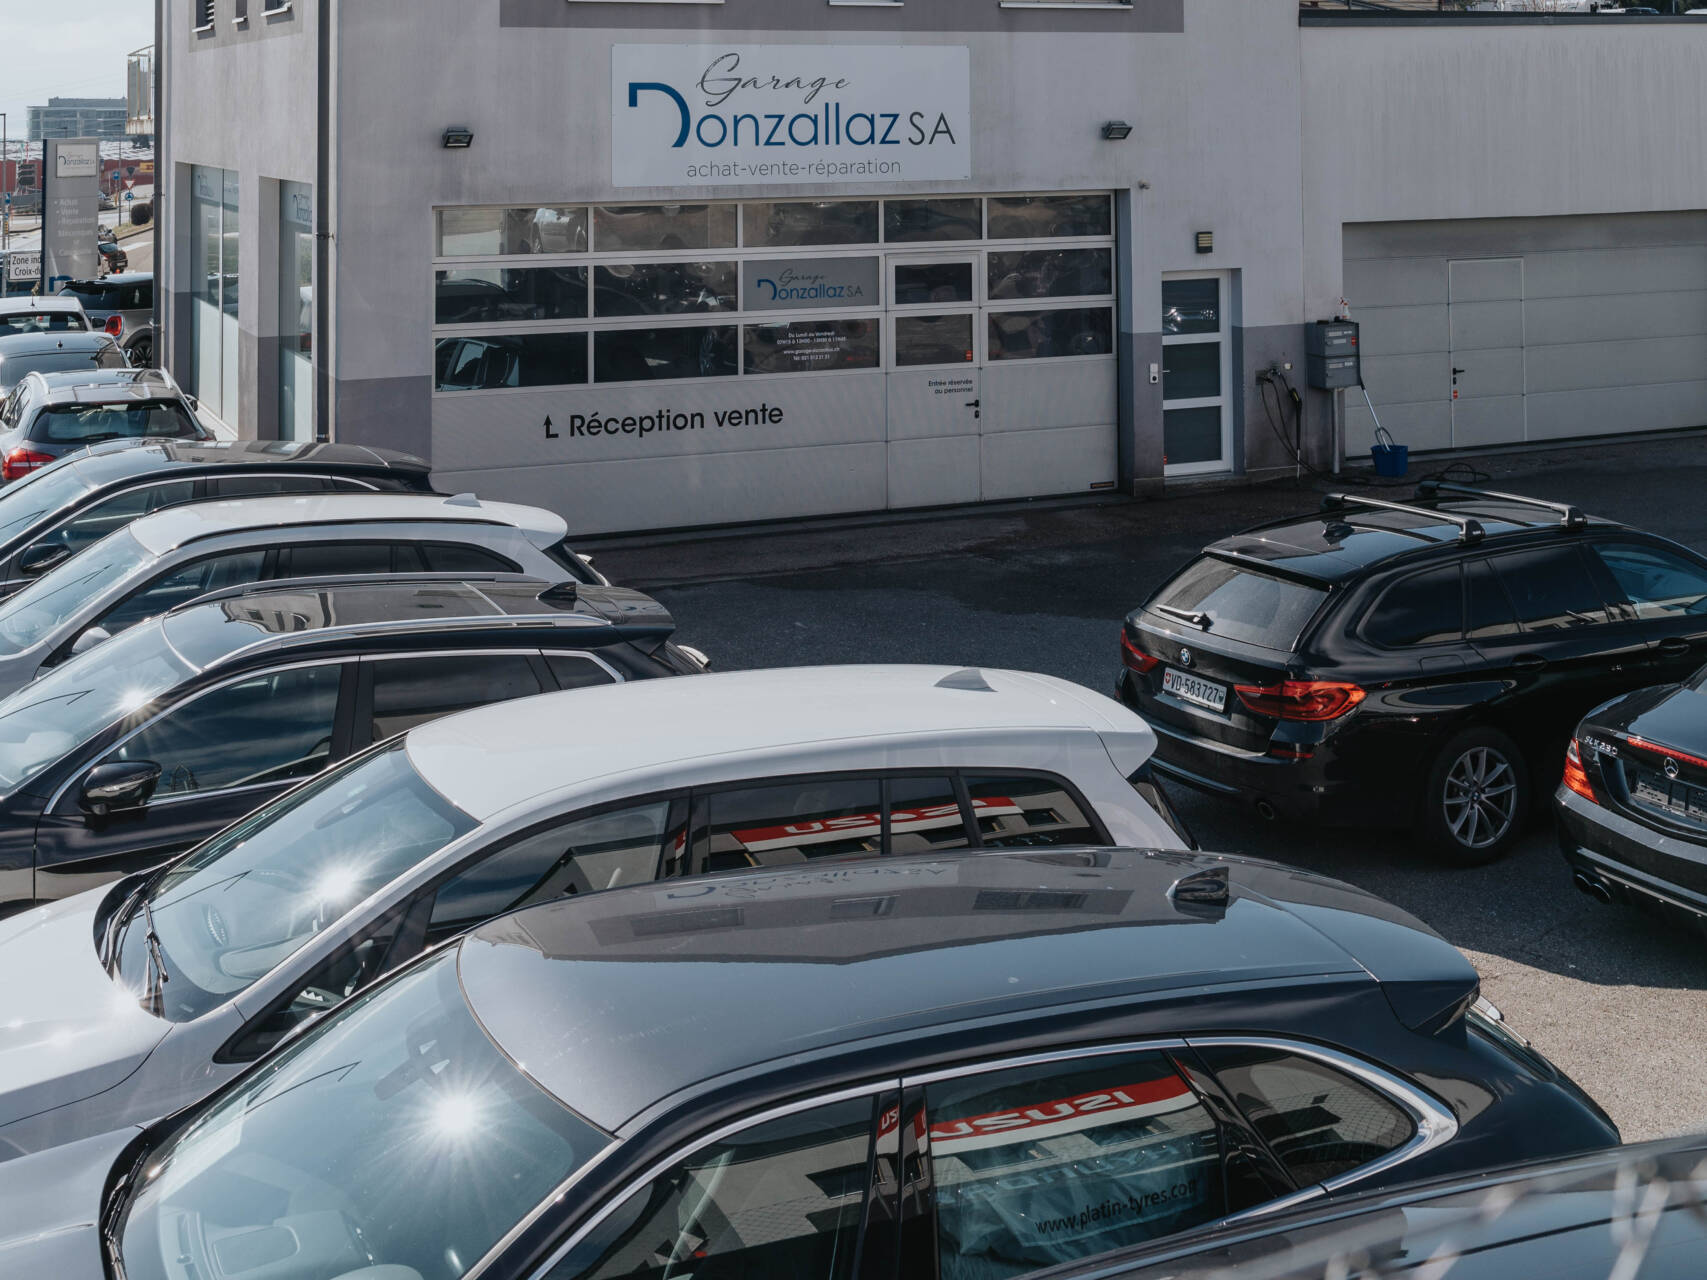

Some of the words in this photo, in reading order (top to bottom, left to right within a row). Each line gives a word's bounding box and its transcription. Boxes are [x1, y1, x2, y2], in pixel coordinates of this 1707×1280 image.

[695, 53, 850, 107] Garage
[628, 82, 901, 148] Donzallaz
[907, 111, 956, 146] SA
[686, 158, 901, 178] achat-vente-réparation
[12, 255, 30, 265] Zone
[778, 268, 828, 286] Garage
[757, 278, 845, 301] Donzallaz
[846, 285, 864, 298] SA
[928, 379, 947, 387] Entrée
[948, 378, 973, 386] réservée
[944, 386, 973, 395] personnel
[569, 409, 705, 438] Réception
[713, 403, 784, 428] vente
[1584, 736, 1600, 747] SLK
